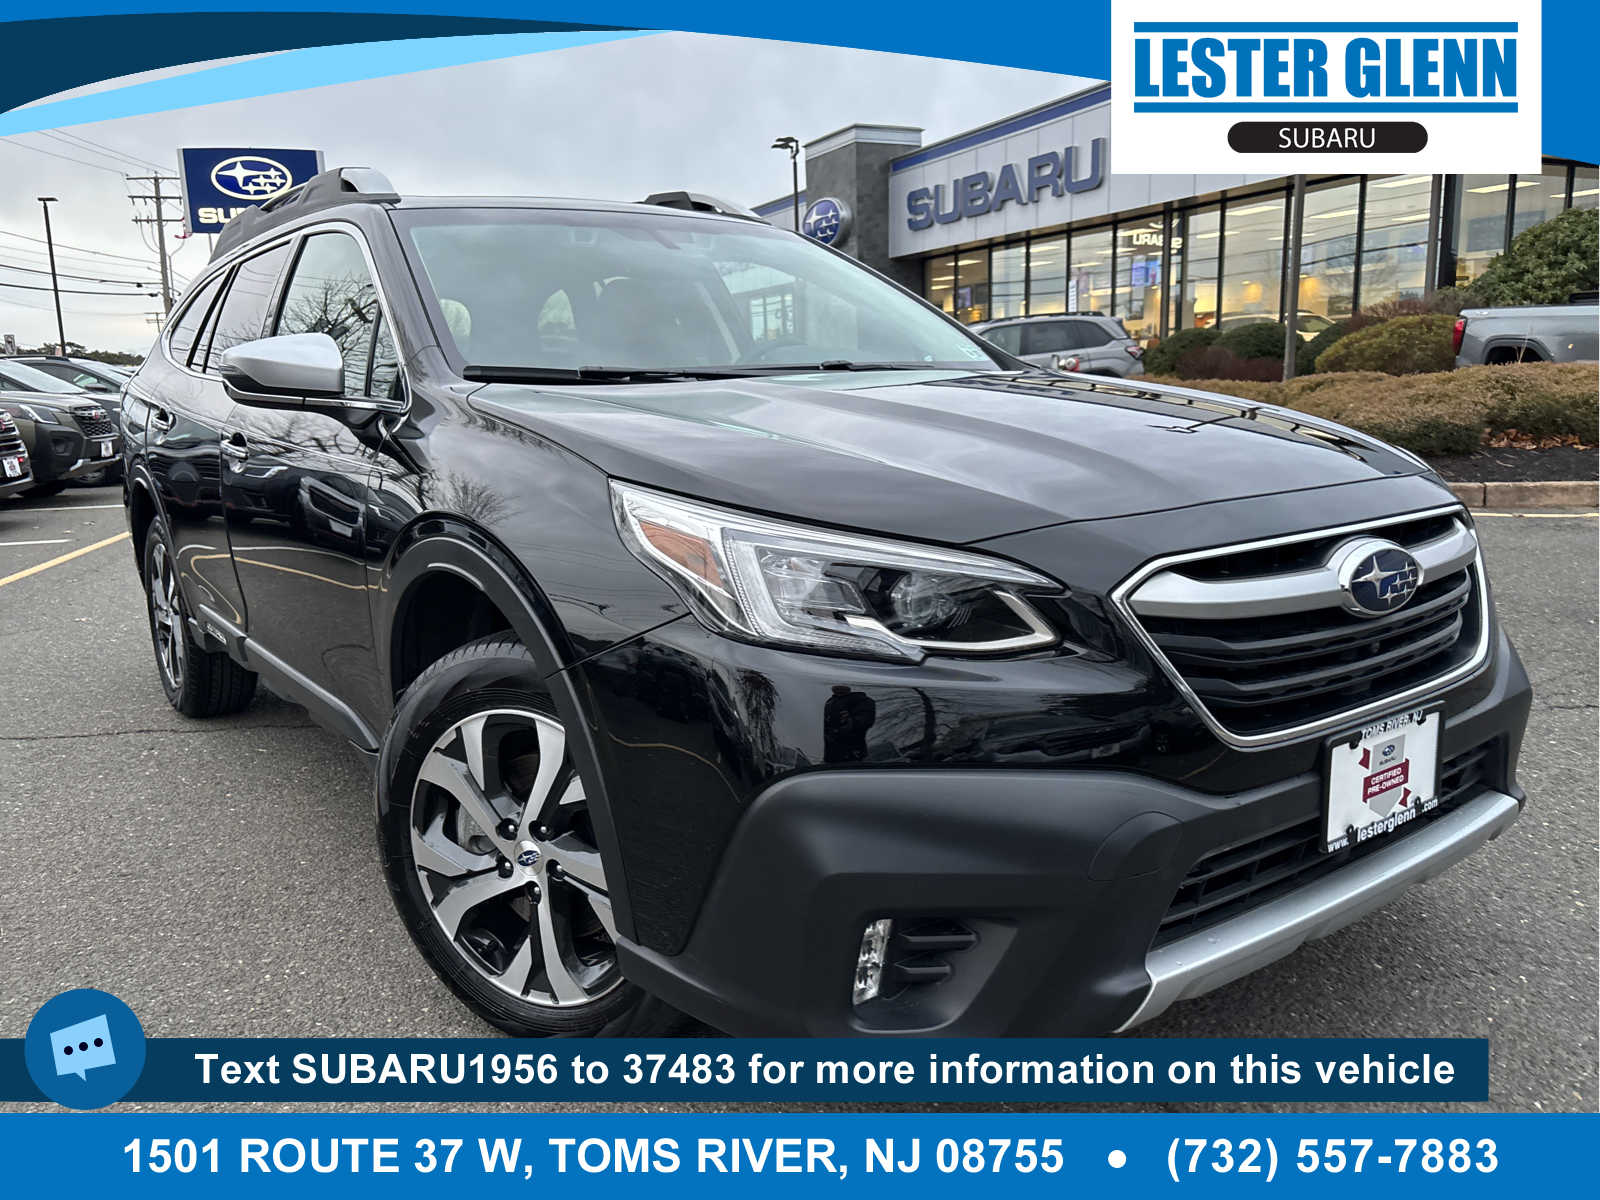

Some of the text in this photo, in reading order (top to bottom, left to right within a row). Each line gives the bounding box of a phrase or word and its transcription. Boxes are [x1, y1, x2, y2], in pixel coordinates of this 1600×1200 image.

[907, 138, 1106, 231] SUBARU
[198, 207, 246, 224] SU
[1362, 723, 1386, 739] TOMS
[1413, 709, 1424, 721] NJ
[1367, 774, 1405, 795] PRE-OWNED
[1370, 767, 1402, 785] CERTIFIED
[1357, 808, 1416, 842] lesterglenn
